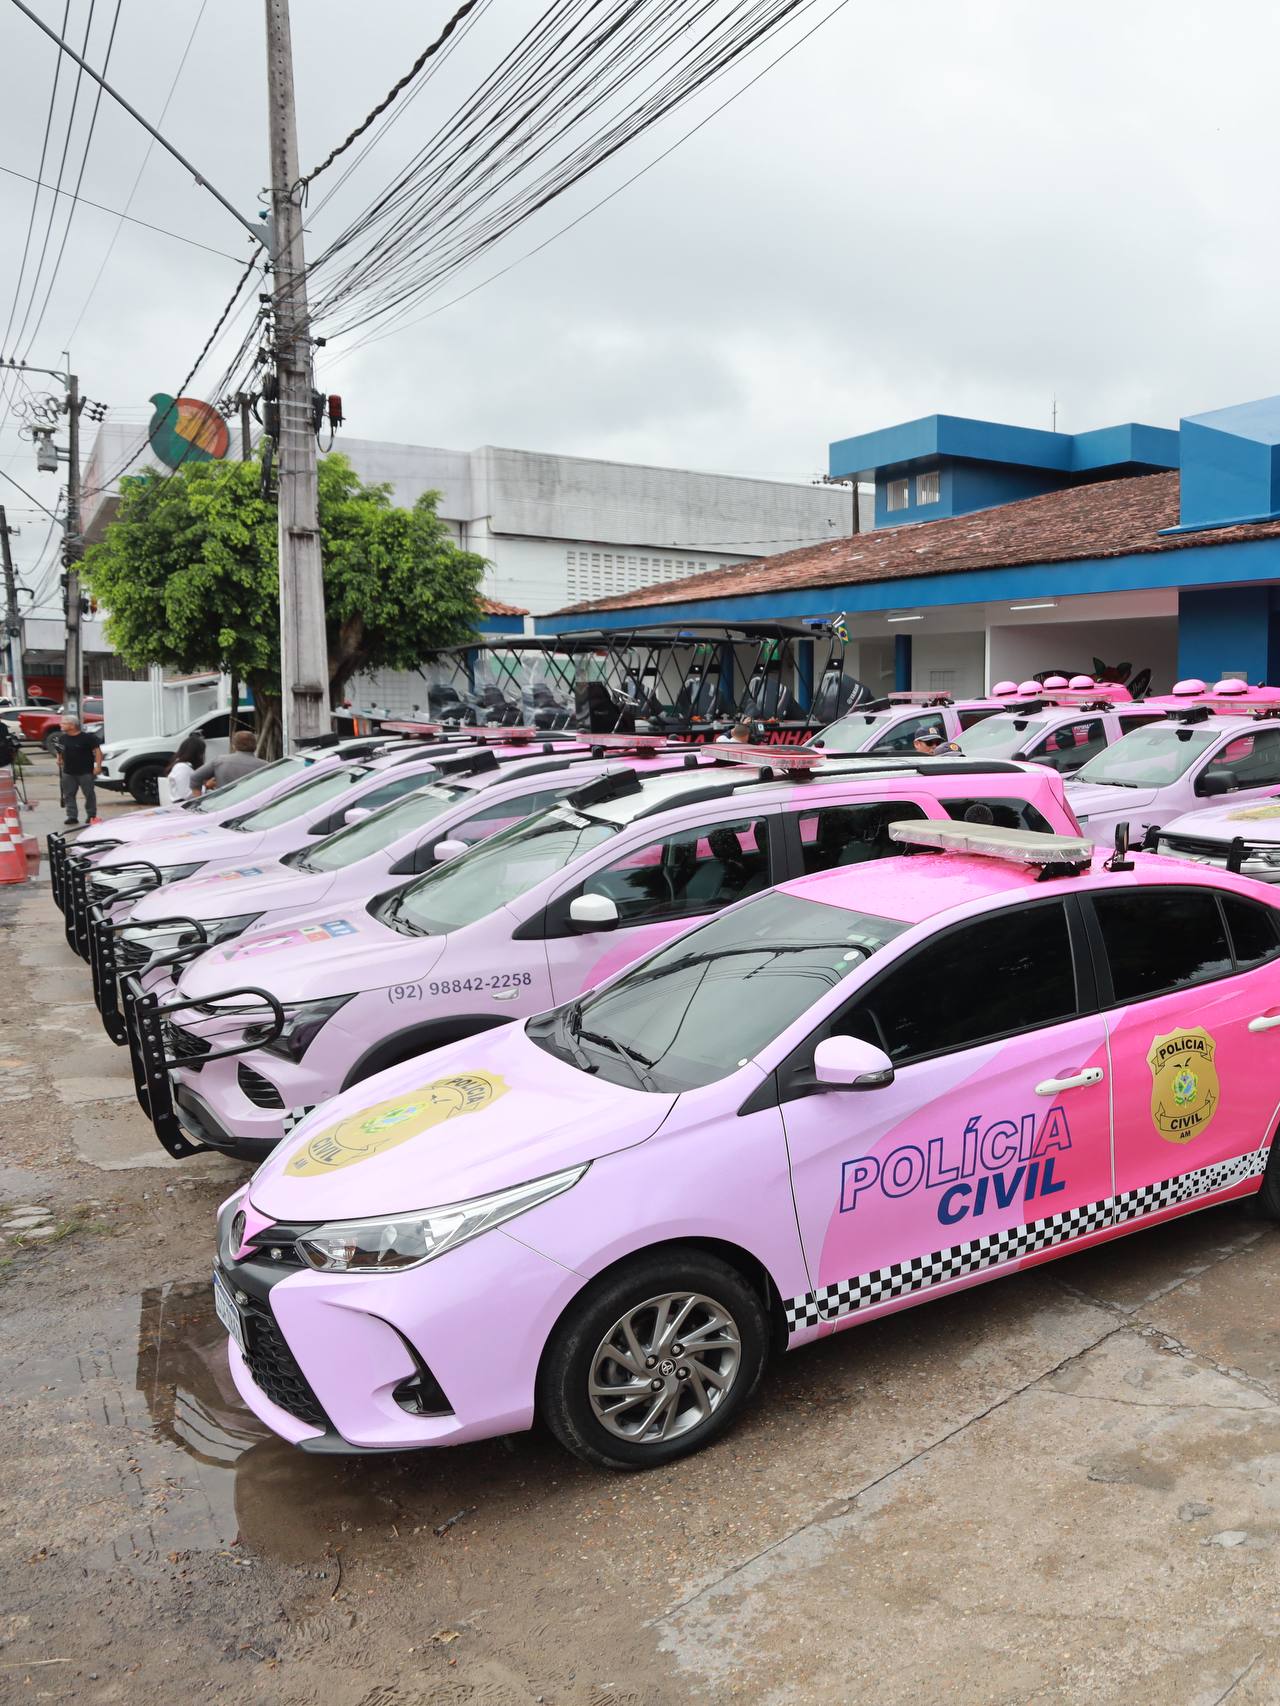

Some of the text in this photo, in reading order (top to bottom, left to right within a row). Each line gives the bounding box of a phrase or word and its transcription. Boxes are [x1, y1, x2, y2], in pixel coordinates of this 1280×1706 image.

[387, 972, 532, 1004] (92) 98842-2258
[1159, 1037, 1205, 1060] POLÍCIA
[1170, 1113, 1203, 1130] CIVIL
[1180, 1130, 1191, 1139] AM
[313, 1136, 334, 1163] CIVIL
[839, 1106, 1073, 1214] POLÍCIA
[937, 1157, 1066, 1226] CIVIL
